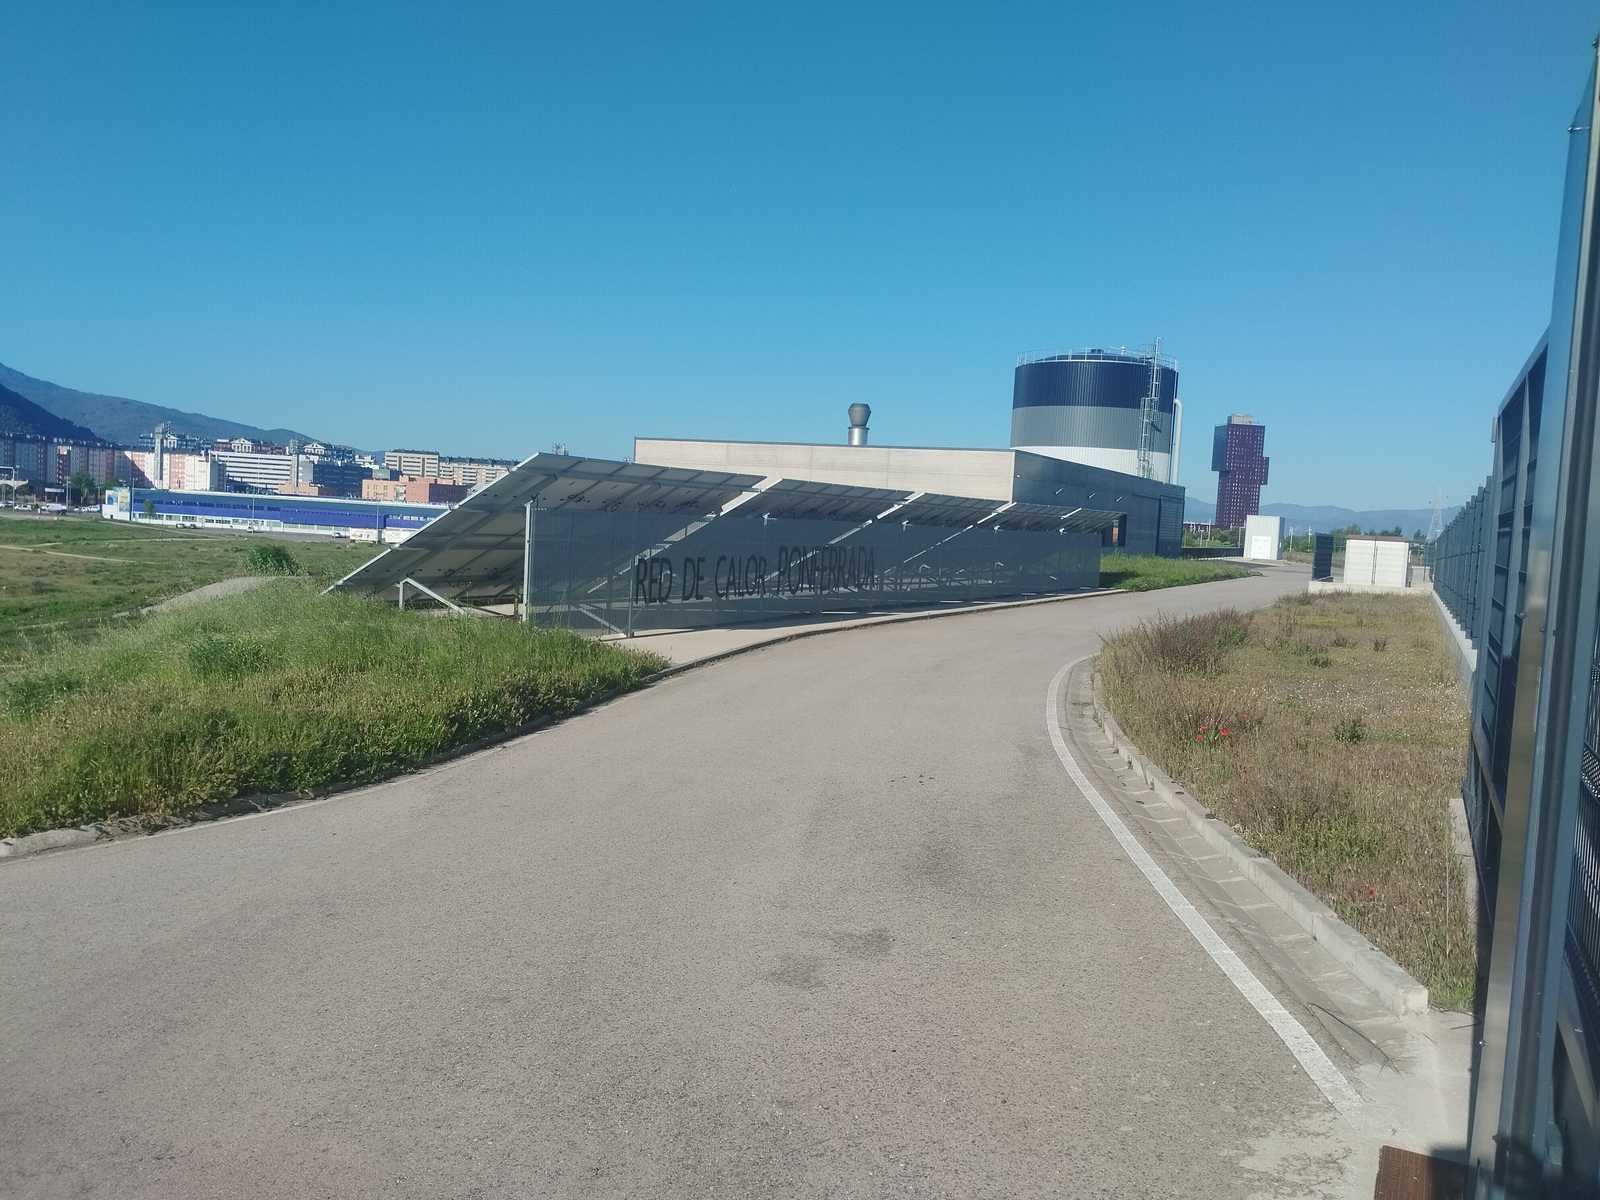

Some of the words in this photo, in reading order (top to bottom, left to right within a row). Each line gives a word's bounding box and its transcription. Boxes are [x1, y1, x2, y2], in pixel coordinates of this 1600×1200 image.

[634, 556, 673, 603] RED
[682, 556, 704, 600] DE
[714, 554, 767, 597] CALOR
[777, 544, 877, 593] PONFERRADA
